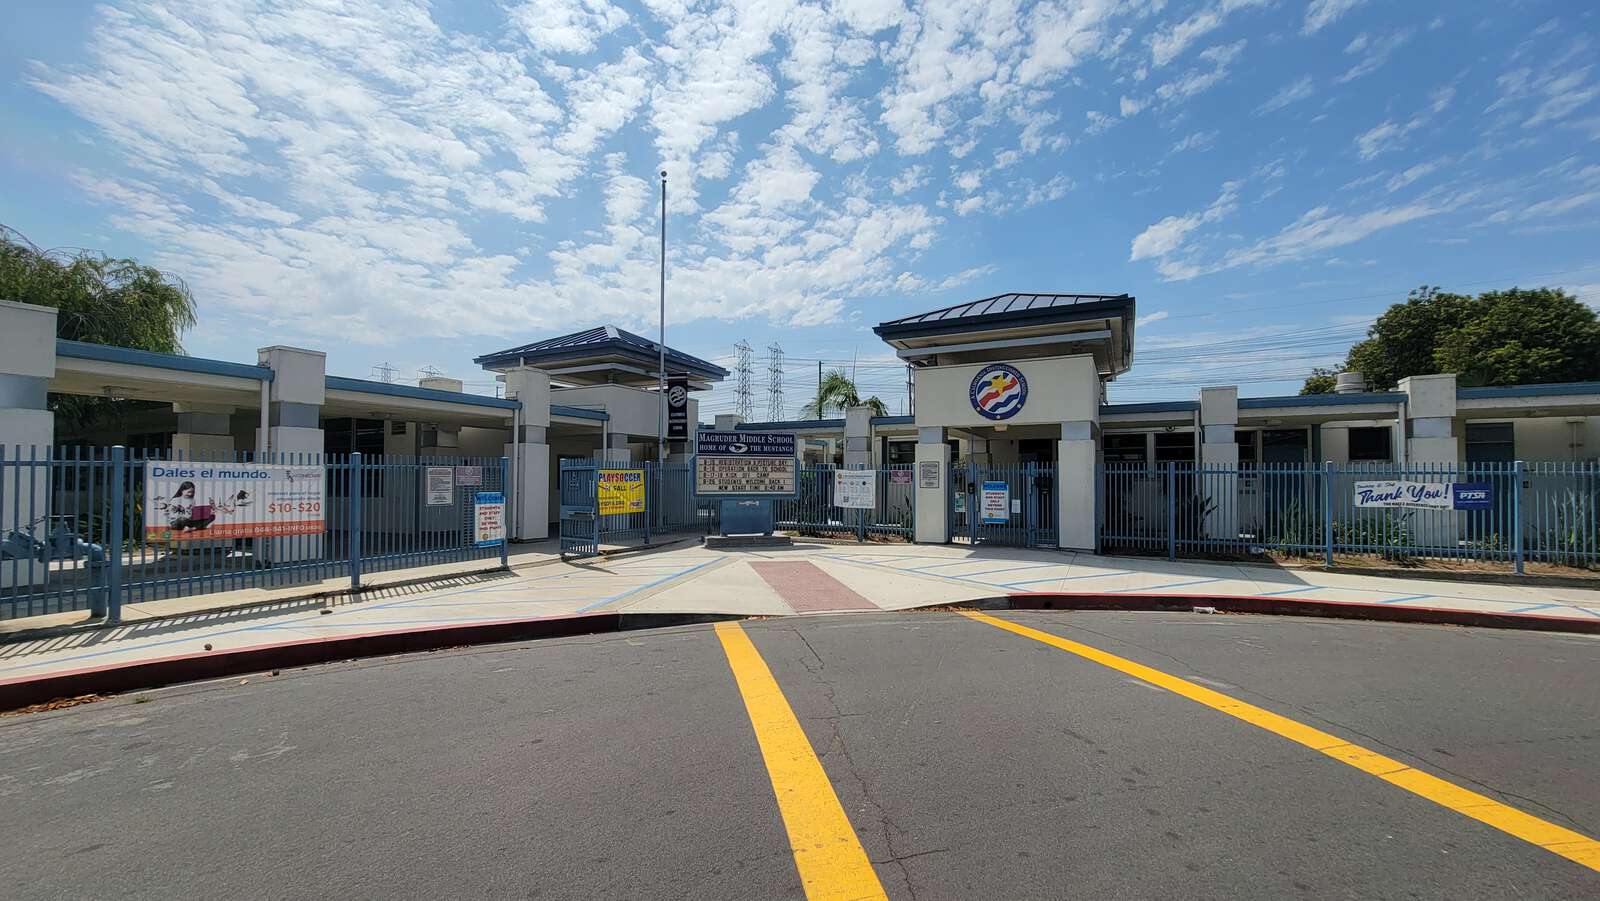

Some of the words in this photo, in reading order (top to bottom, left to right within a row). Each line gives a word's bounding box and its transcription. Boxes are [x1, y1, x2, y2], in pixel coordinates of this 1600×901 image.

[740, 433, 766, 443] MIDDLE
[768, 434, 793, 444] SCHOOL
[153, 467, 197, 478] Dales
[200, 468, 214, 478] el
[218, 468, 272, 479] mundo.
[1358, 486, 1402, 505] Thank
[1406, 484, 1449, 502] You!
[268, 501, 321, 514] $10-$20
